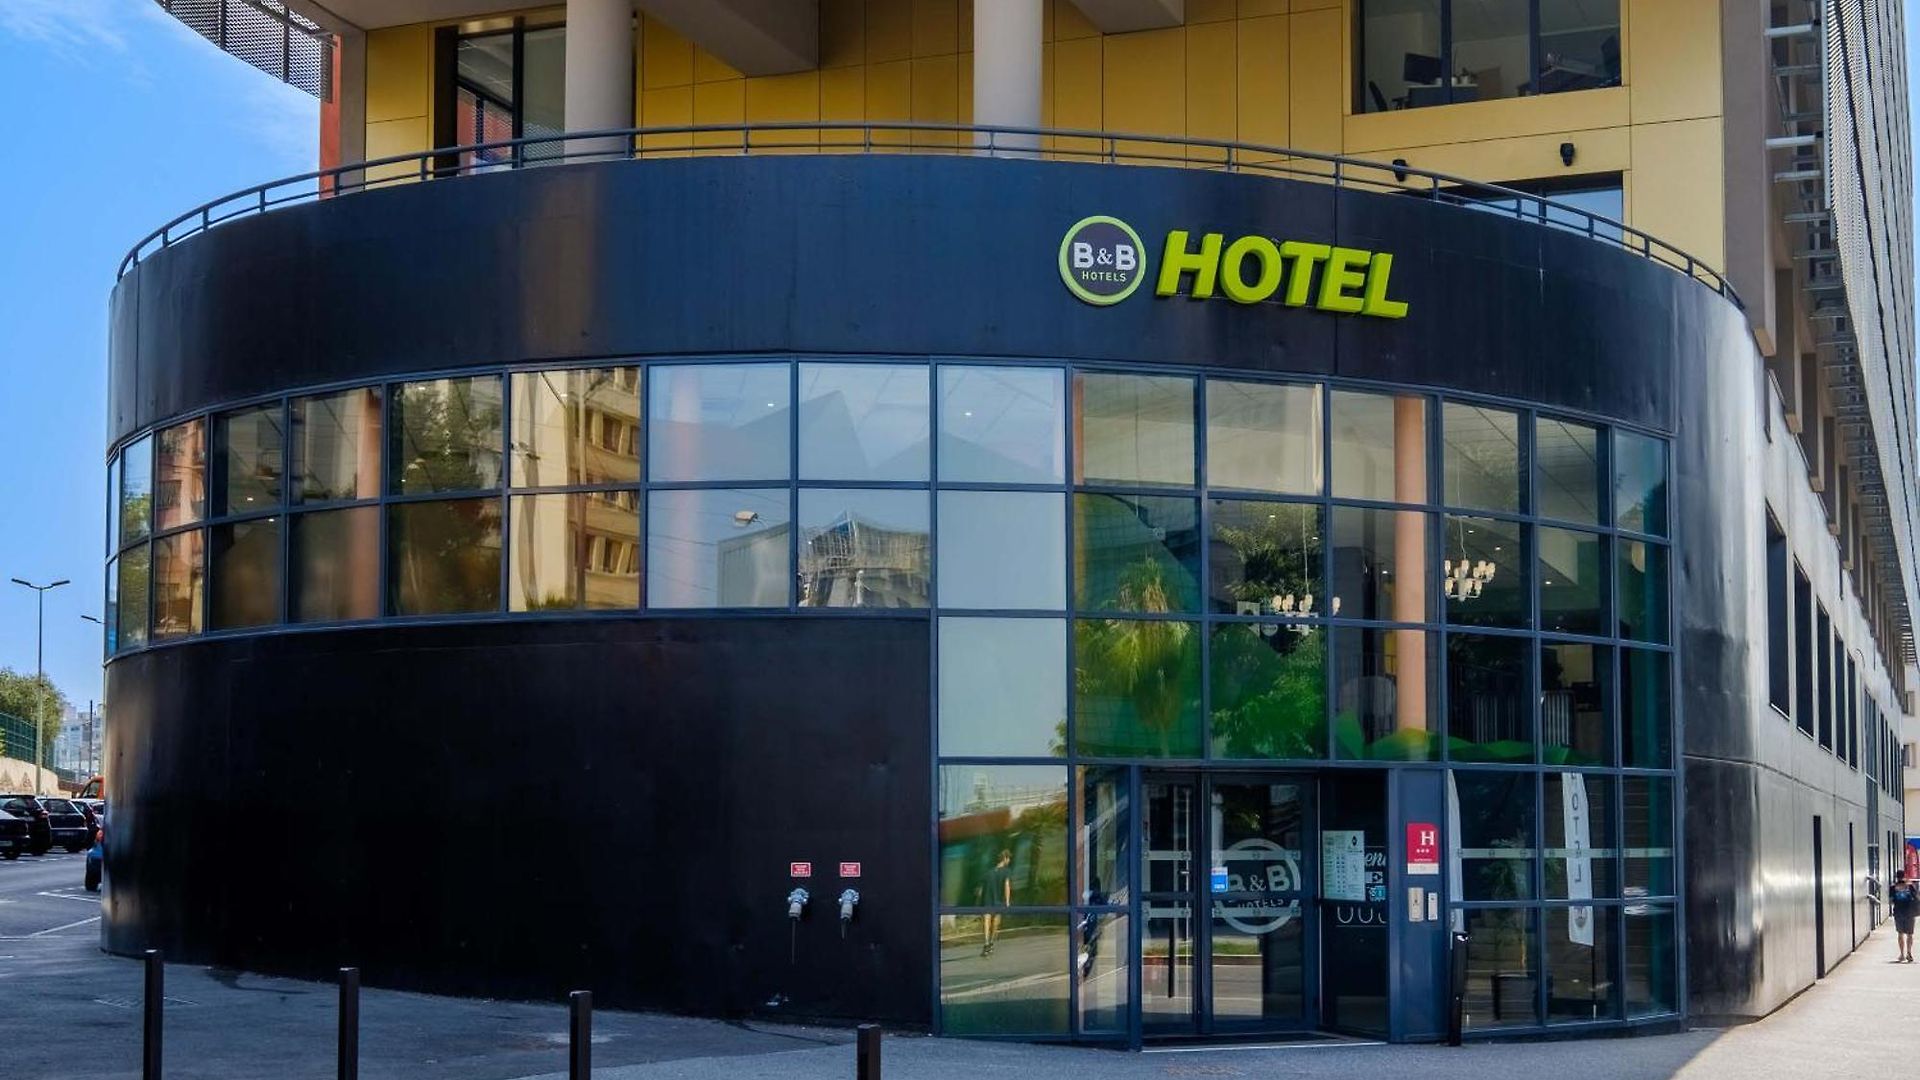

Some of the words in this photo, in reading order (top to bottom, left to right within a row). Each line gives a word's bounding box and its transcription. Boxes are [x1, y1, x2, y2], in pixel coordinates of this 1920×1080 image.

[1074, 242, 1136, 270] B&B
[1082, 271, 1127, 282] HOTELS
[1156, 230, 1409, 319] HOTEL
[1421, 831, 1434, 846] H
